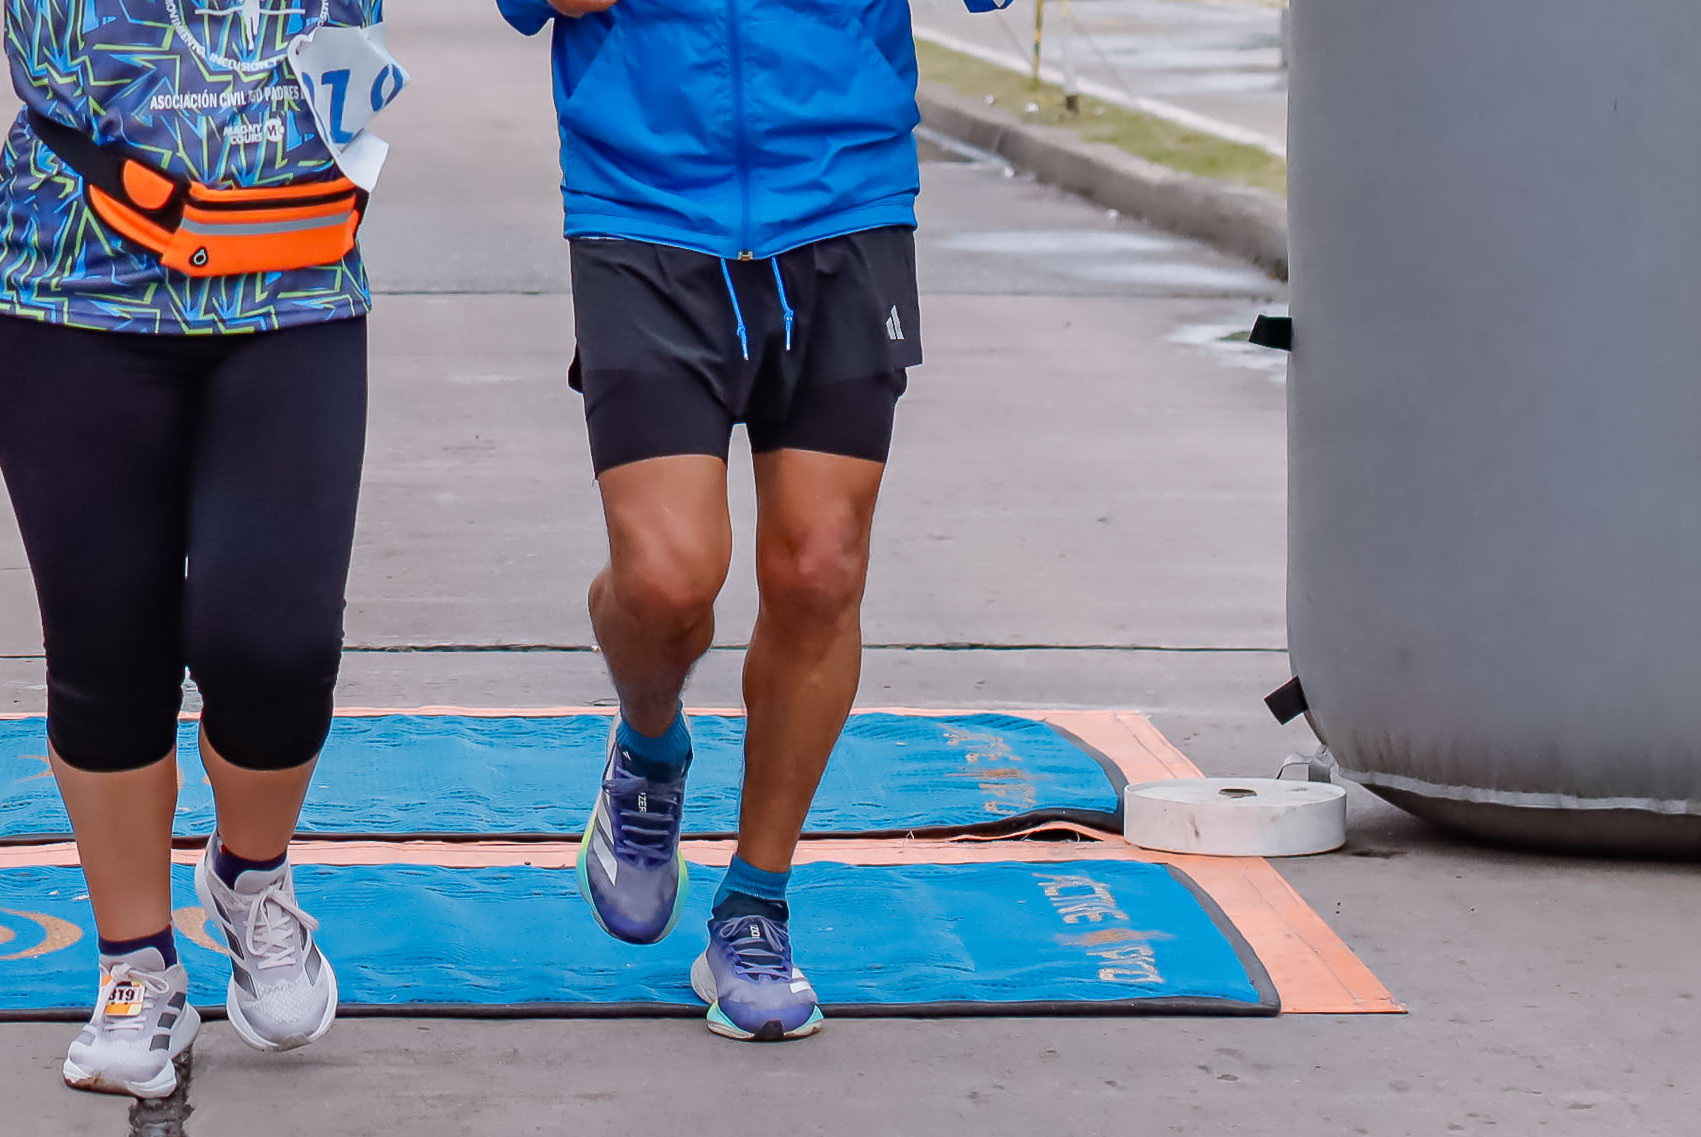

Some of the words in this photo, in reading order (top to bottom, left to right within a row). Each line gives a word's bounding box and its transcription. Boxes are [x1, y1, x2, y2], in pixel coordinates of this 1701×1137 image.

[150, 89, 217, 110] ASOCIACIÓN
[219, 91, 247, 108] CIVIL
[264, 85, 300, 102] PADRES
